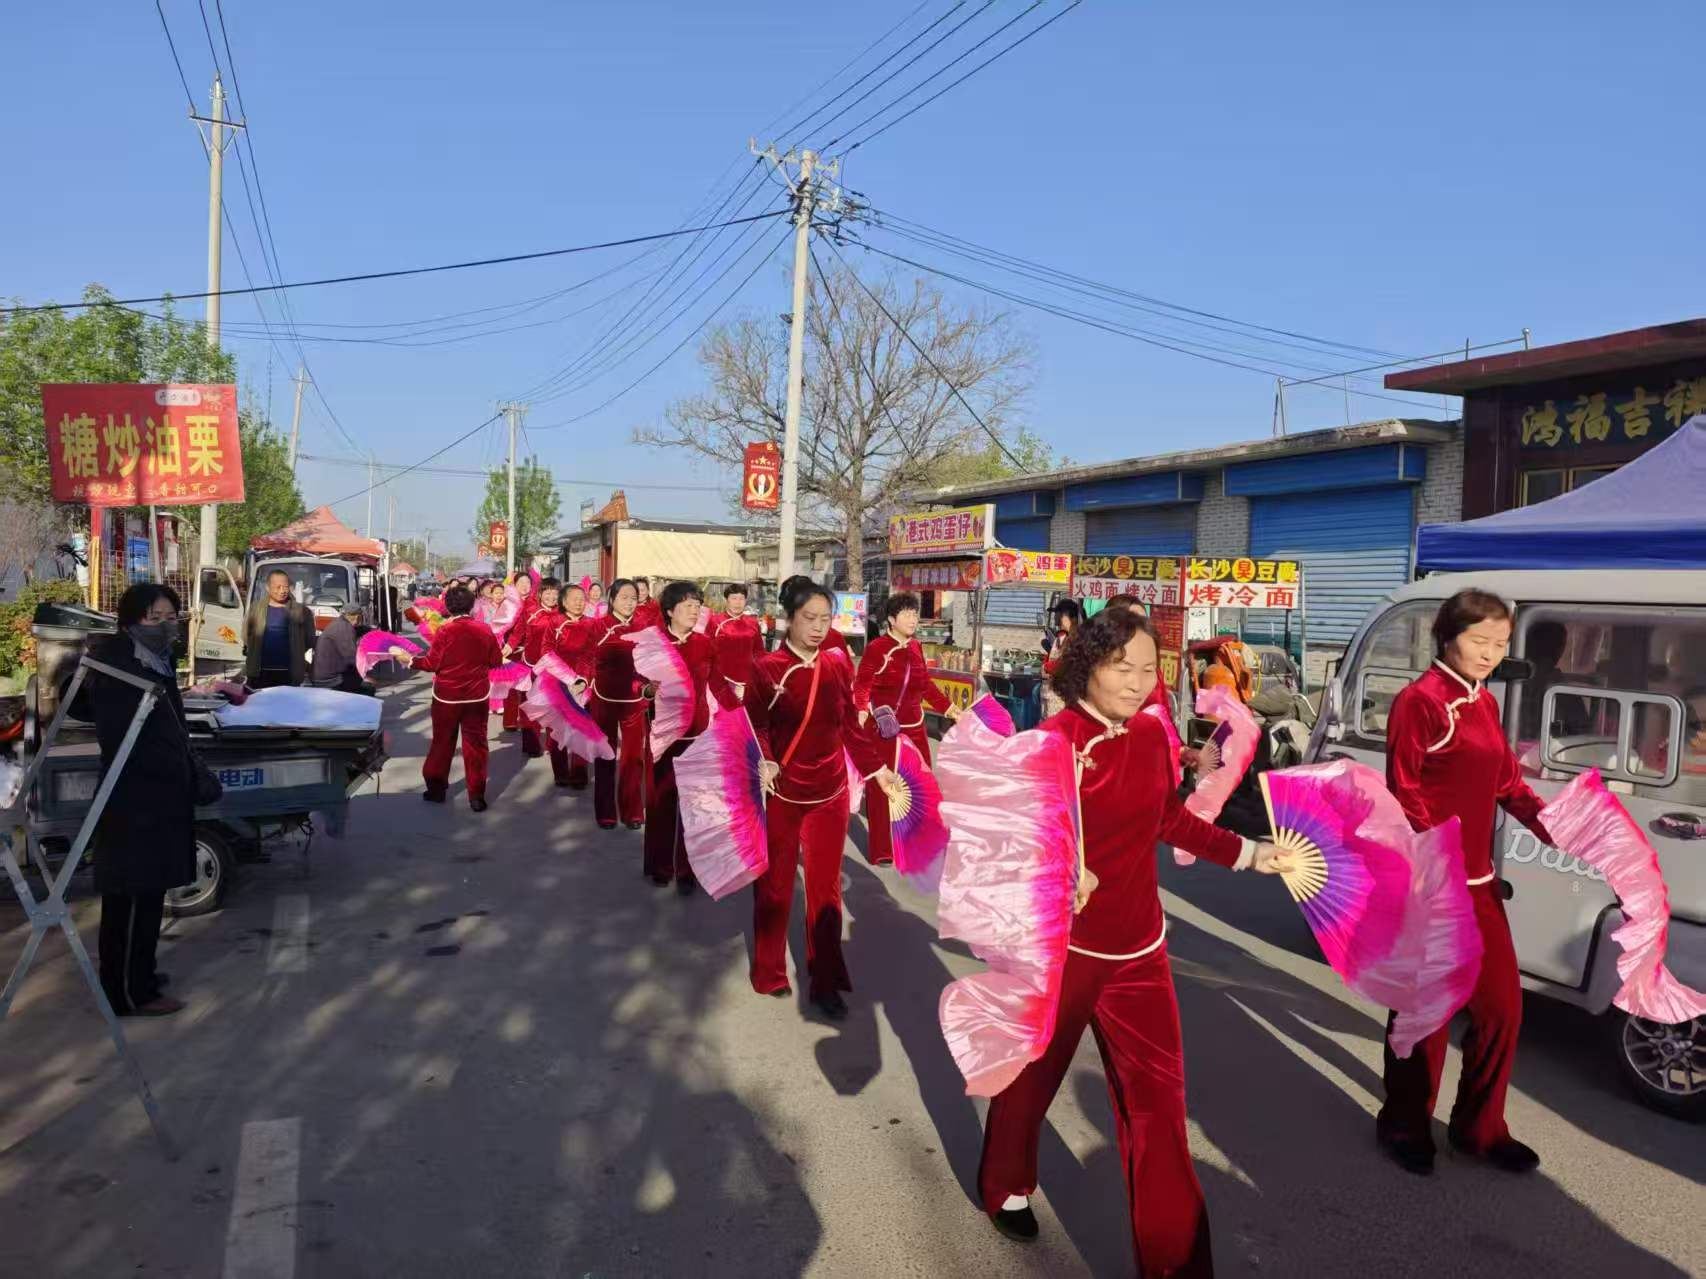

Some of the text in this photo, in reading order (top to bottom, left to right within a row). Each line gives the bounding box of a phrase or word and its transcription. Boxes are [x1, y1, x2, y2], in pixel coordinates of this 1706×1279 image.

[59, 412, 224, 478] 糖炒油栗
[159, 481, 218, 497] 香甜可口
[906, 511, 972, 544] 港式鸡蛋仔
[1077, 556, 1177, 580] 长沙臭豆腐
[1187, 557, 1298, 583] 长沙臭豆腐
[1075, 580, 1178, 605] 火鸡面 烤冷面
[1189, 583, 1297, 608] 烤冷面
[219, 767, 264, 787] 电动
